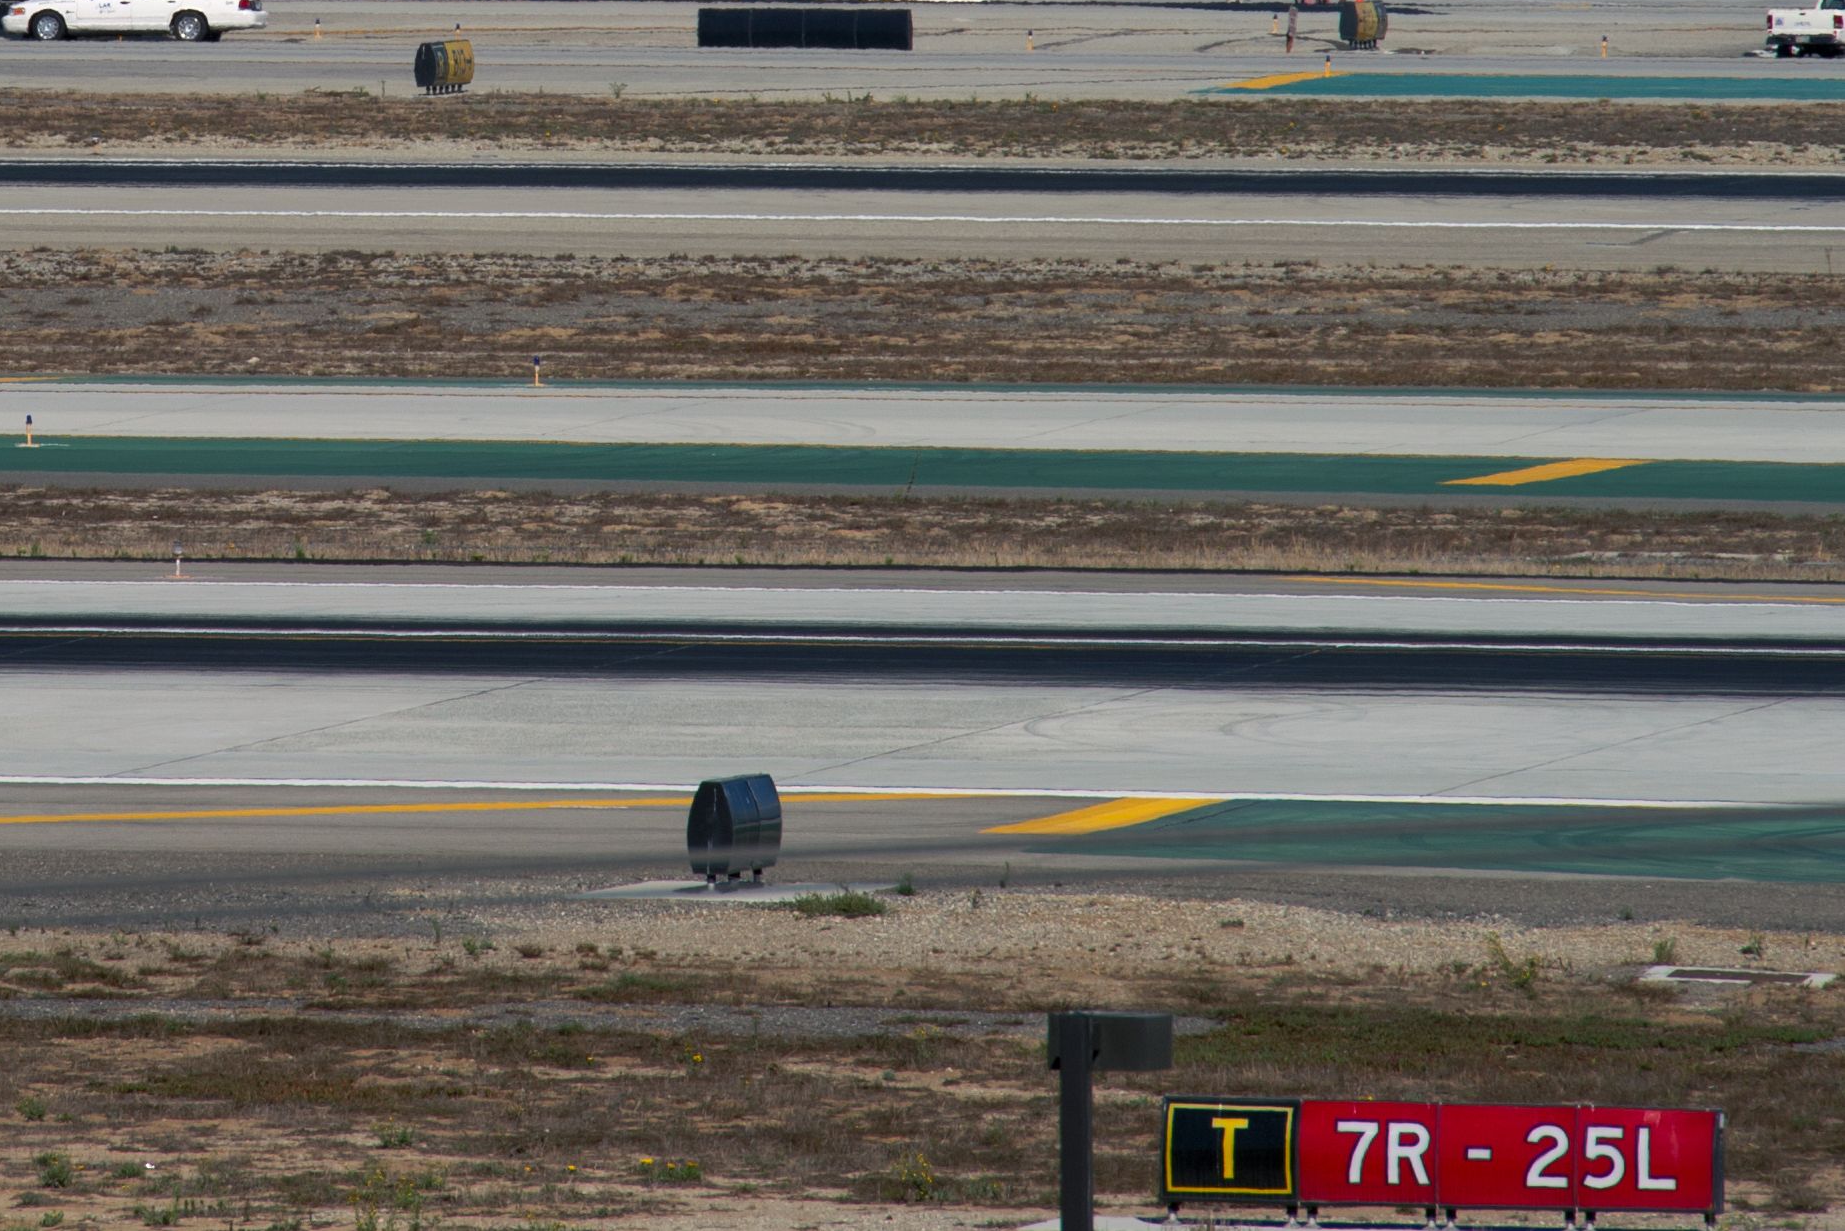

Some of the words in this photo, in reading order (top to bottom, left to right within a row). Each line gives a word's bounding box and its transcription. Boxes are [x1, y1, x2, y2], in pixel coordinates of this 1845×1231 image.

[1212, 1117, 1248, 1179] T
[1336, 1120, 1430, 1185] 7R
[1467, 1149, 1491, 1160] -
[1525, 1125, 1677, 1190] 25L
